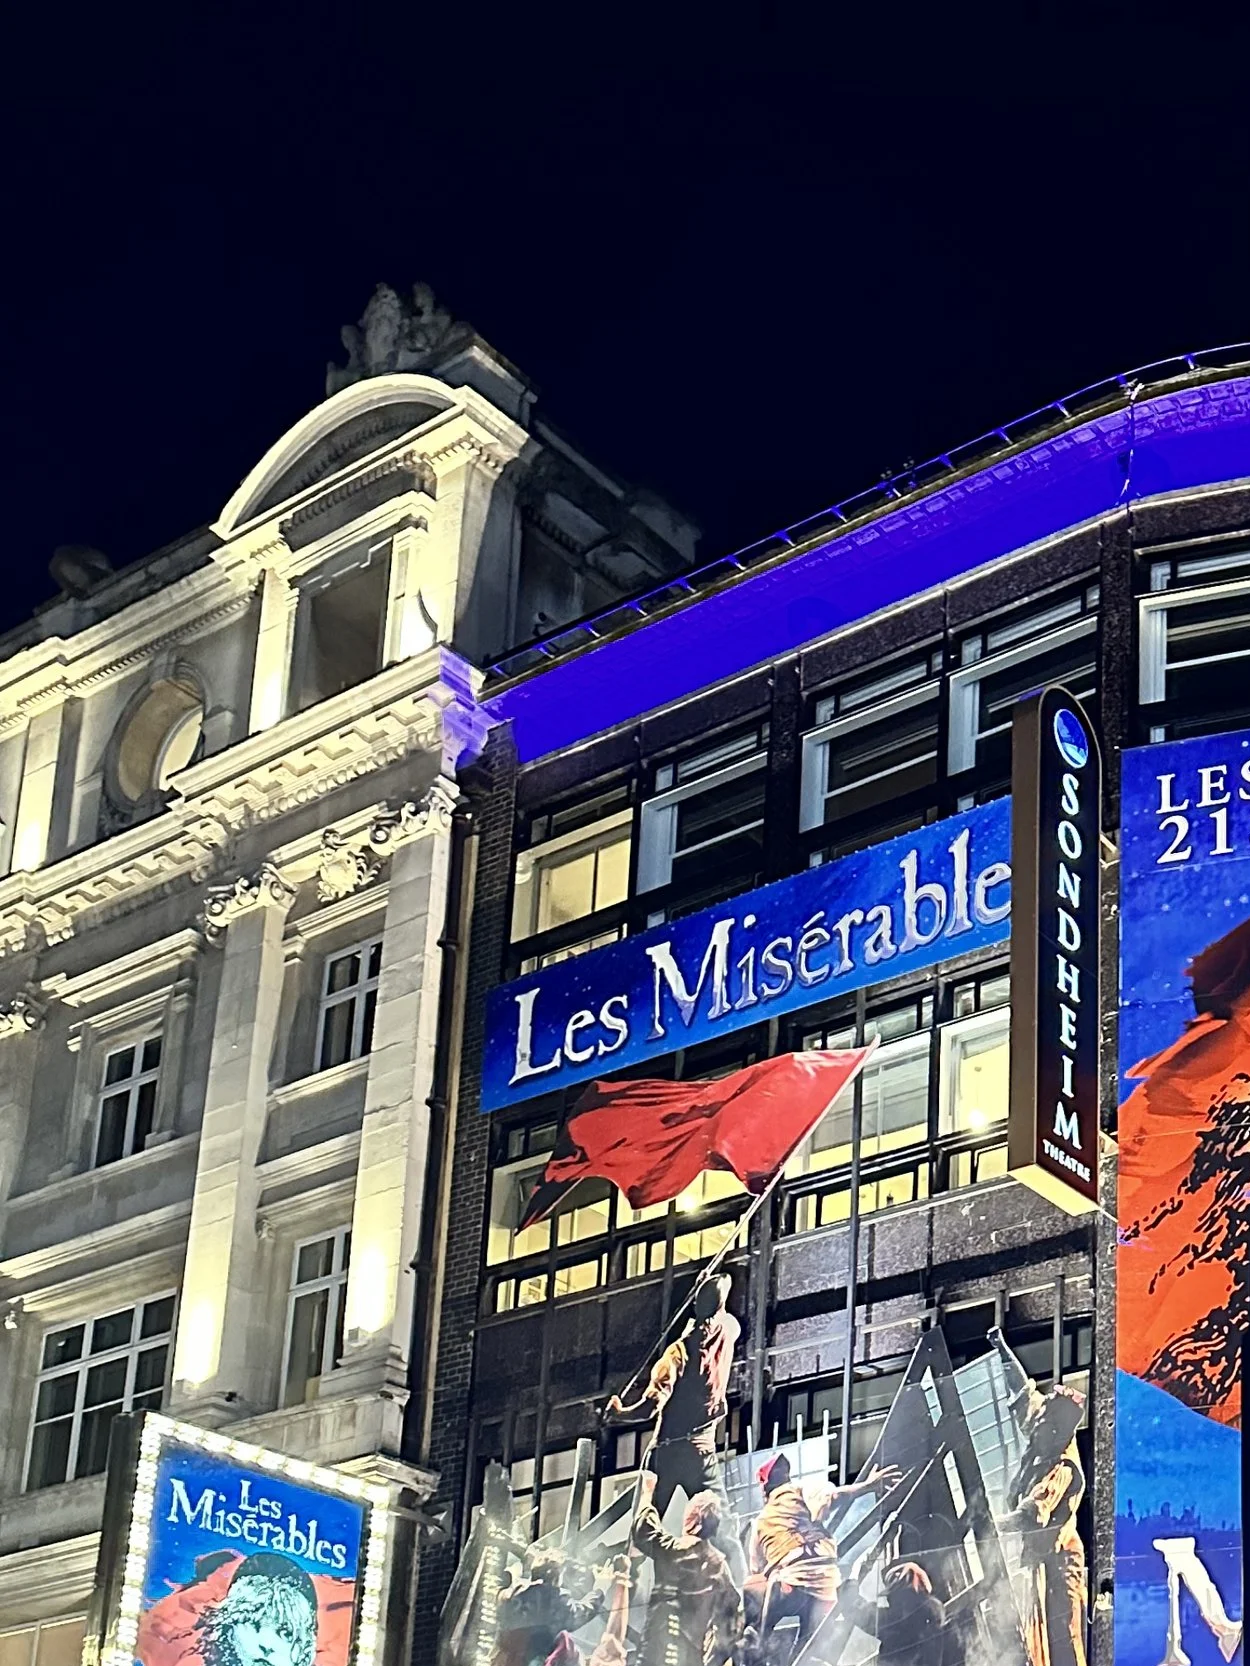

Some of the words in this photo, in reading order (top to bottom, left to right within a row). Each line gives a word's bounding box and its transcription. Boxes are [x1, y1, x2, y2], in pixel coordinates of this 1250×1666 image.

[507, 987, 630, 1086] Les
[645, 828, 1012, 1041] Misérable
[1053, 774, 1083, 1150] SONDHEIM
[1042, 1138, 1091, 1183] THEATRE
[165, 1477, 348, 1570] Misérables
[237, 1479, 283, 1520] Les
